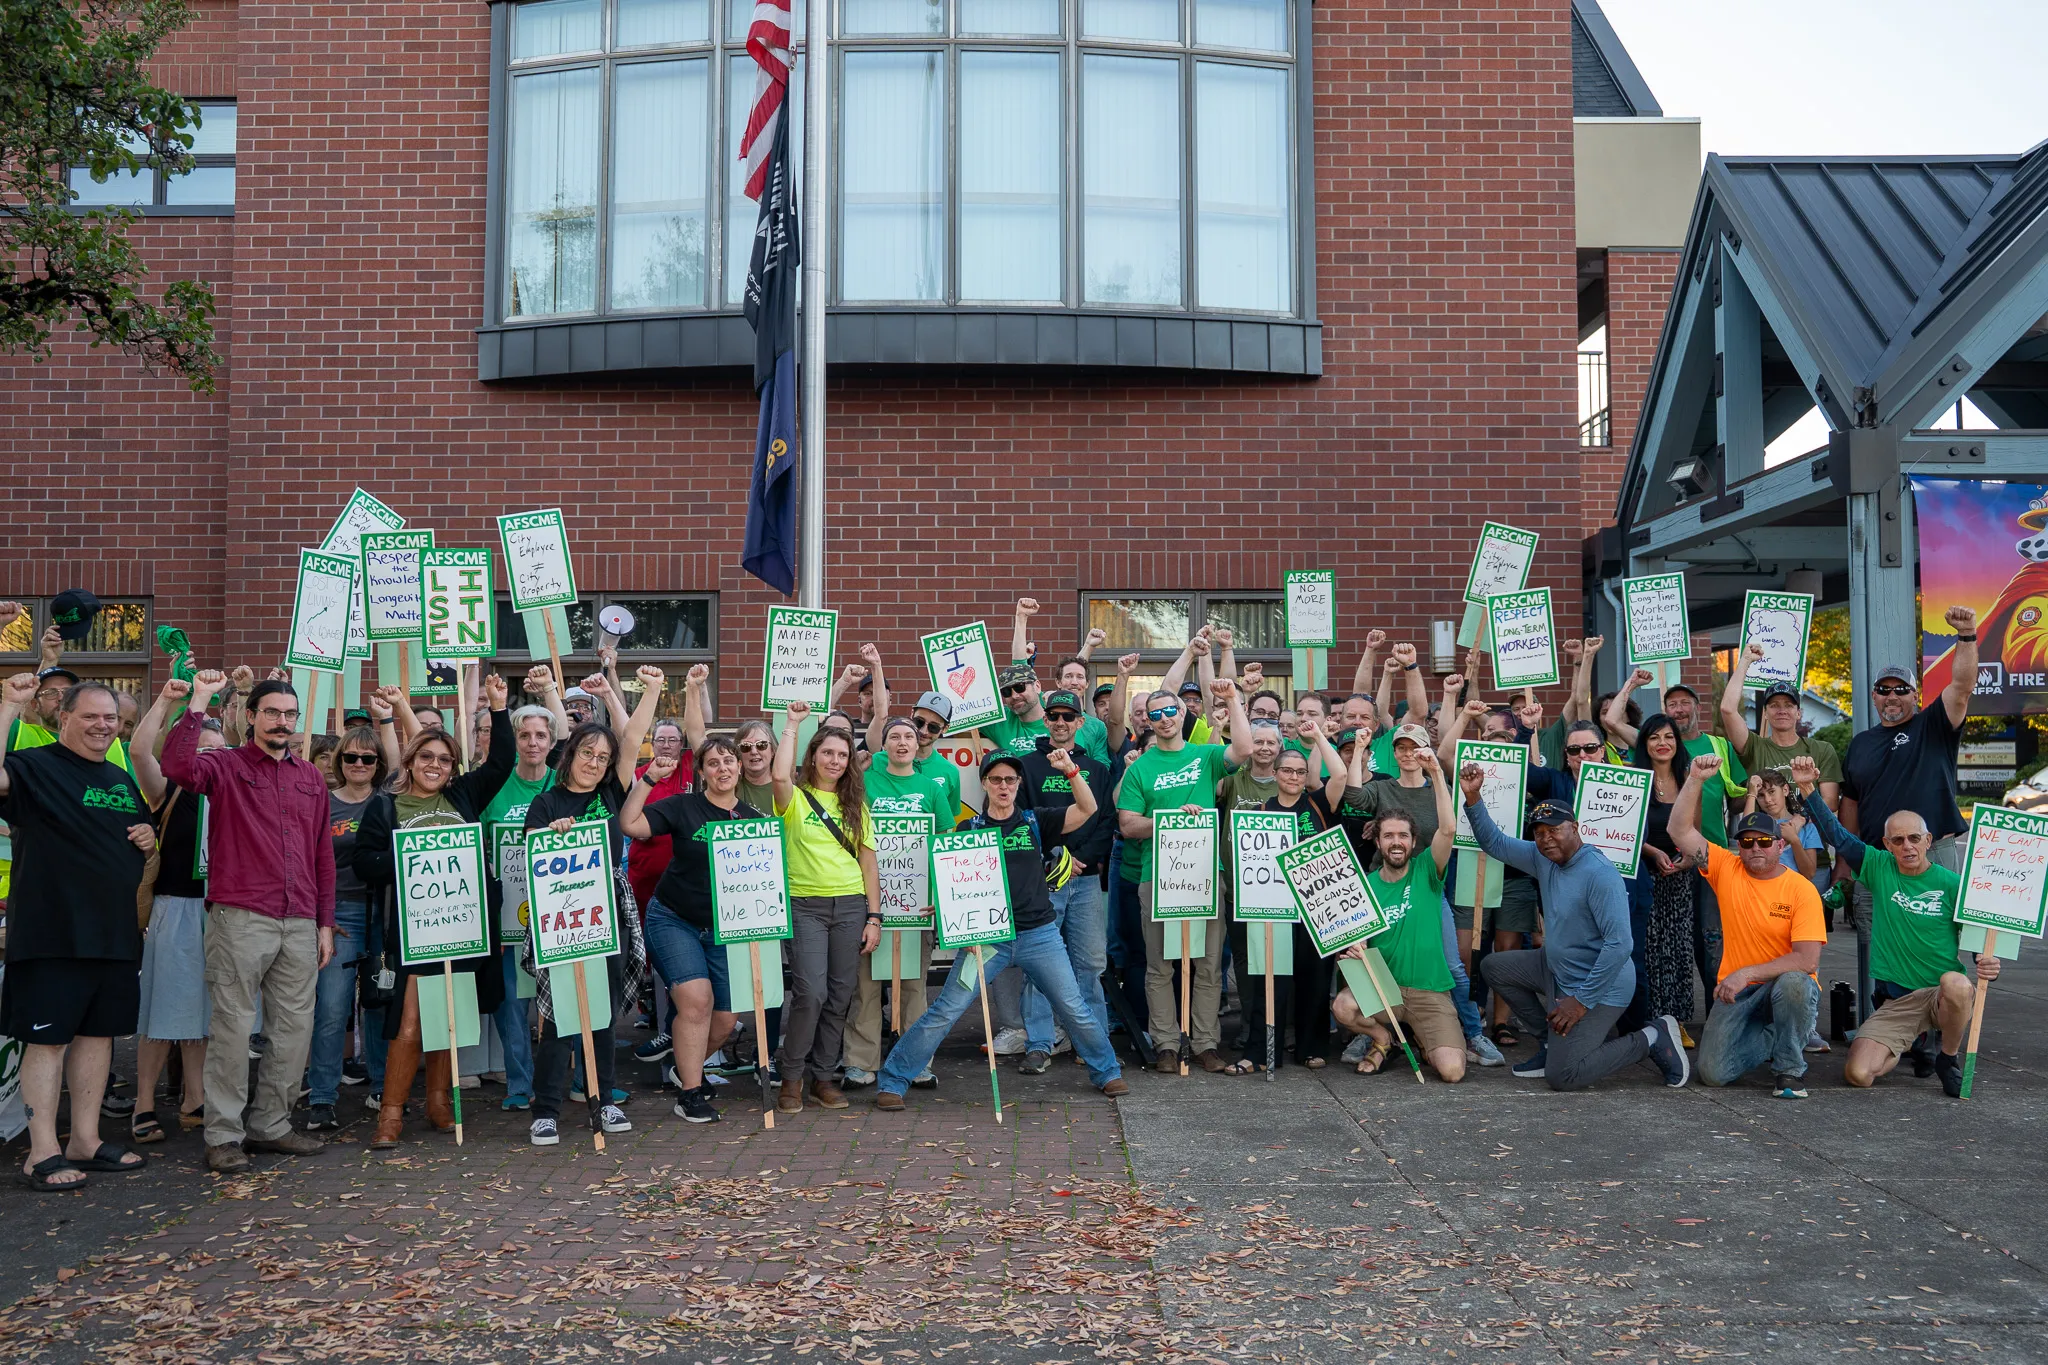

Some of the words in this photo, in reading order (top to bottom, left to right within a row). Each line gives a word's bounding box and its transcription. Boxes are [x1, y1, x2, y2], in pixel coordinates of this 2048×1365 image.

[355, 494, 400, 529] AFSCME
[505, 514, 558, 530] AFSCME
[366, 535, 428, 549] AFSCME
[510, 533, 531, 546] City
[1486, 527, 1533, 547] AFSCME
[520, 542, 556, 557] Employee
[1485, 539, 1511, 554] Proud
[367, 552, 419, 566] Respec
[423, 552, 487, 565] AFSCME
[1482, 550, 1501, 563] City
[304, 555, 352, 577] AFSCME
[304, 576, 331, 590] COST
[335, 580, 348, 593] OF
[520, 572, 540, 587] City
[1287, 572, 1331, 582] AFSCME
[1628, 577, 1678, 592] AFSCME
[1300, 585, 1315, 593] NO
[1475, 579, 1493, 591] City
[307, 595, 338, 607] LIVING
[370, 595, 421, 609] Longevit
[1295, 595, 1325, 604] MORE
[1493, 593, 1546, 610] AFSCME
[1630, 591, 1675, 604] Long-Time
[1750, 596, 1807, 610] AFSCME
[385, 610, 422, 621] Matte
[1290, 606, 1327, 620] Monkey
[1495, 605, 1545, 623] RESPECT
[1630, 604, 1680, 616] Workers
[774, 612, 832, 627] AFSCME
[1632, 621, 1666, 633] Valued
[1755, 616, 1776, 635] fair
[298, 623, 317, 636] OUR
[319, 626, 343, 640] WAGES
[778, 630, 820, 640] MAYBE
[1497, 623, 1547, 638] LONG-TERM
[929, 628, 982, 652] AFSCME
[1498, 636, 1550, 654] WORKERS
[1634, 640, 1670, 654] LONGEVITY
[1673, 638, 1685, 648] PAY
[1762, 638, 1785, 648] wages
[777, 645, 796, 656] PAY
[806, 648, 818, 656] US
[772, 662, 810, 670] ENOUGH
[942, 646, 965, 672] I
[772, 676, 796, 686] LIVE
[802, 677, 827, 685] HERE?
[2009, 673, 2045, 686] FIRE
[930, 696, 941, 705] C
[1461, 746, 1522, 762] AFSCME
[1154, 769, 1201, 788] AFSCME
[1585, 767, 1646, 787] AFSCME
[83, 789, 136, 808] AFSCME
[1597, 789, 1618, 800] COST
[1588, 800, 1623, 814] LIVING
[1159, 815, 1213, 828] AFSCME
[1237, 815, 1292, 830] AFSCME
[1747, 815, 1758, 826] C
[712, 821, 780, 840] AFSCME
[1581, 825, 1599, 836] OUR
[1606, 829, 1635, 842] WAGES
[1980, 827, 2001, 843] WE
[2008, 833, 2046, 849] CAN'T
[402, 831, 475, 851] AFSCME
[531, 828, 602, 852] AFSCME
[911, 836, 925, 850] of
[932, 832, 997, 852] AFSCME
[1160, 834, 1206, 856] Respect
[1240, 832, 1290, 851] COLA
[717, 847, 741, 859] The
[747, 844, 774, 860] City
[1242, 853, 1270, 861] SHOULD
[1284, 833, 1343, 870] AFSCME
[1974, 847, 2006, 859] EAT
[2010, 850, 2045, 864] YOUR
[408, 855, 461, 877] FAIR
[533, 849, 600, 877] COLA
[940, 857, 971, 870] The
[974, 850, 998, 870] City
[1169, 856, 1196, 872] Your
[1292, 848, 1349, 886] CORVALLIS
[726, 861, 771, 875] Works
[952, 871, 991, 882] Works
[1298, 863, 1357, 900] WORKS
[410, 878, 470, 899] COLA
[722, 880, 776, 893] because
[951, 887, 1001, 901] because
[1160, 878, 1212, 895] Workers!
[1971, 877, 1992, 891] FOR
[2001, 885, 2033, 901] PAY!
[562, 894, 579, 909] &
[880, 892, 917, 908] AGES
[1307, 882, 1359, 913] BECAUSE
[721, 904, 748, 921] We
[755, 892, 784, 917] Do!
[1310, 906, 1337, 930] WE
[1339, 891, 1366, 913] DO!
[541, 905, 603, 933] FAIR
[944, 911, 980, 932] WE
[1318, 924, 1336, 939] FAIR
[1335, 917, 1350, 931] PAY
[1351, 909, 1369, 922] NOW
[1963, 908, 1994, 920] OREGON
[1995, 915, 2026, 926] COUNCIL
[557, 926, 612, 945] WAGES!!
[720, 930, 748, 938] OREGON
[749, 927, 778, 935] COUNCIL
[944, 934, 972, 943] OREGON
[973, 931, 1001, 940] COUNCIL
[409, 946, 440, 954] OREGON
[442, 942, 473, 951] COUNCIL
[542, 947, 572, 957] OREGON
[573, 942, 603, 952] COUNCIL
